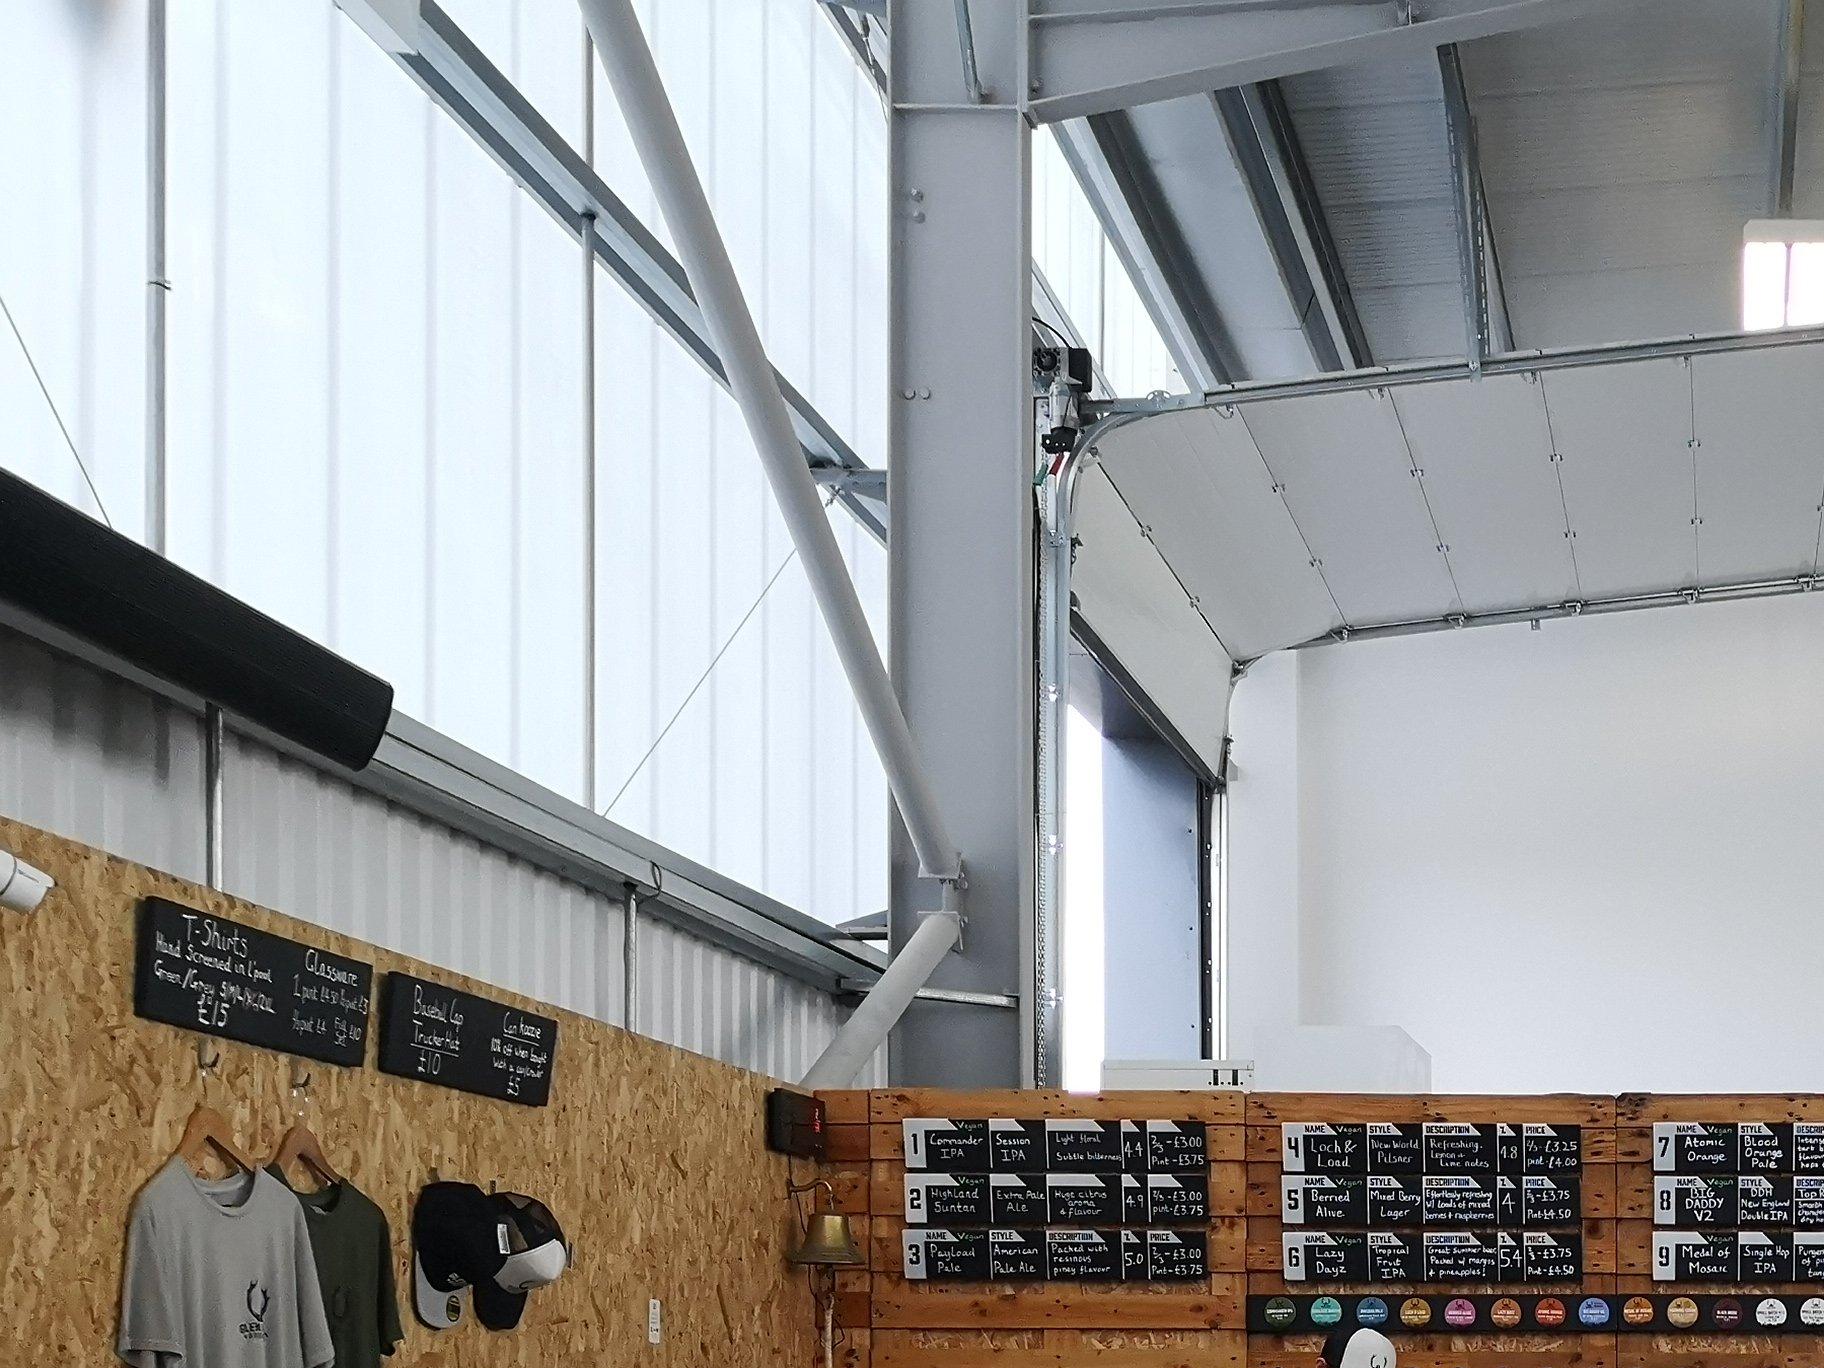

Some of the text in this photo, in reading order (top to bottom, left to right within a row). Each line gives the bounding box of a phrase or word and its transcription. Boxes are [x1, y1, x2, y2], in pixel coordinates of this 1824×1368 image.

[182, 914, 248, 958] T-Shirts
[305, 949, 358, 986] Glassware
[197, 997, 230, 1027] £15
[413, 1019, 445, 1046] Trucker
[417, 1050, 441, 1075] £10
[1304, 1125, 1325, 1133] NAME
[1369, 1125, 1391, 1134] STYLE
[1525, 1126, 1545, 1134] PRICE
[911, 1134, 918, 1154] 1
[930, 1133, 983, 1146] Commander
[996, 1133, 1031, 1146] Session
[1371, 1139, 1420, 1150] New World
[1684, 1138, 1726, 1147] Atomic
[1744, 1137, 1778, 1146] Blood
[1288, 1137, 1299, 1158] 4
[1311, 1139, 1342, 1153] Loch
[1659, 1137, 1669, 1157] 7
[941, 1148, 964, 1158] IPA
[1001, 1149, 1026, 1161] IPA
[1378, 1152, 1413, 1164] Pilsner
[1688, 1152, 1727, 1163] Orange
[1745, 1148, 1783, 1158] Orange
[1317, 1155, 1350, 1168] Load
[1751, 1159, 1777, 1169] Pale
[1741, 1179, 1762, 1187] STYLE
[931, 1189, 979, 1200] Highland
[996, 1190, 1045, 1200] Extra Pale
[1311, 1191, 1350, 1202] Berried
[1690, 1187, 1715, 1197] BIG
[1750, 1188, 1773, 1197] DDH
[909, 1188, 921, 1210] 2
[1288, 1189, 1300, 1210] 5
[1371, 1191, 1421, 1205] Mixed Berry
[1660, 1190, 1670, 1211] 8
[1685, 1198, 1724, 1209] DADDY
[935, 1202, 976, 1213] Suntan
[1007, 1202, 1028, 1213] Ale
[1741, 1199, 1790, 1209] New England
[1316, 1205, 1345, 1218] Alive
[1380, 1207, 1410, 1220] Lager
[1694, 1211, 1714, 1221] V2
[1741, 1210, 1788, 1221] Double IPA
[926, 1232, 946, 1240] NAME
[991, 1232, 1013, 1240] STYLE
[909, 1244, 920, 1265] 3
[930, 1246, 975, 1260] Payload
[993, 1246, 1038, 1256] American
[1315, 1247, 1345, 1262] Lazy
[1372, 1246, 1409, 1257] Tropical
[1659, 1247, 1670, 1266] 9
[1682, 1246, 1731, 1258] Medal of
[1743, 1247, 1772, 1259] Single
[1289, 1247, 1300, 1267] 6
[1377, 1257, 1401, 1266] Fruit
[938, 1262, 962, 1273] Pale
[994, 1262, 1036, 1273] Pale Ale
[1316, 1262, 1347, 1275] Dayz
[1689, 1262, 1728, 1273] Mosaic
[1754, 1262, 1776, 1273] IPA
[1381, 1268, 1406, 1279] IPA
